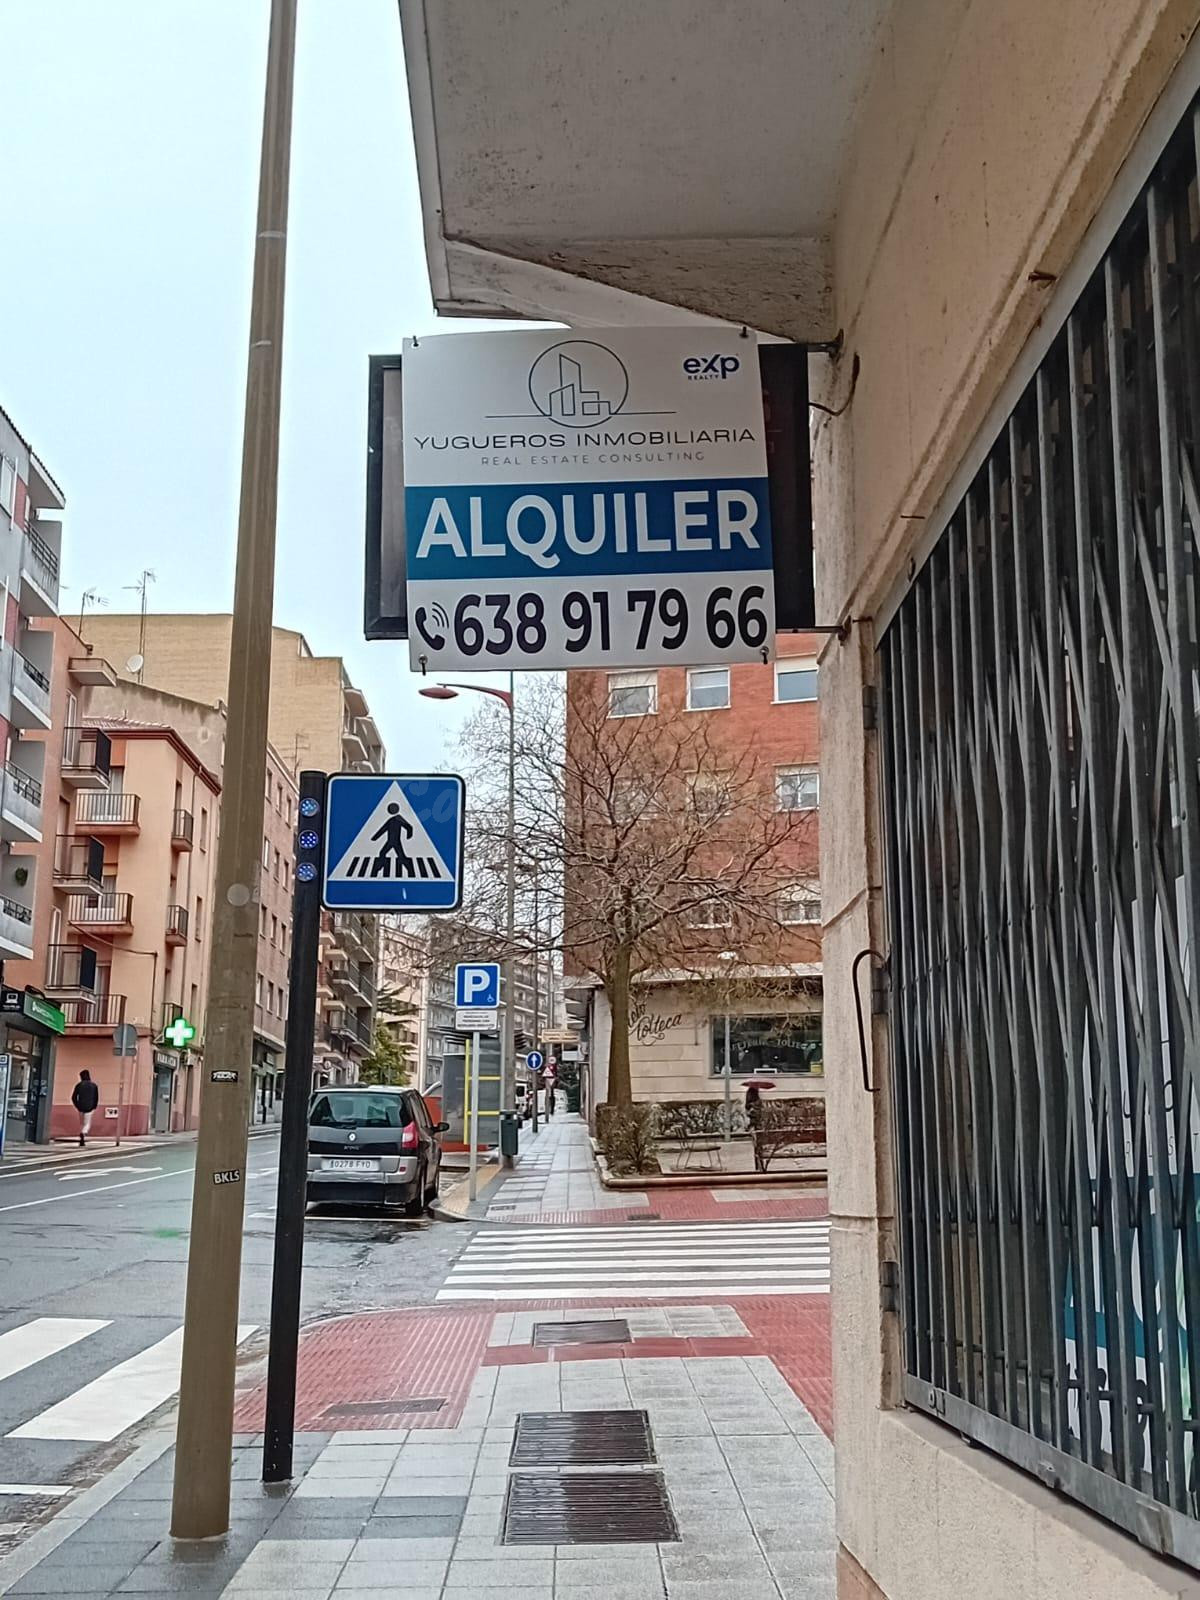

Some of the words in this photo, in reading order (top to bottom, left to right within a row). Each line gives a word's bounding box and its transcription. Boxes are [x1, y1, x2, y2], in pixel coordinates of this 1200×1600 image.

[414, 432, 566, 450] YUGUEROS
[577, 428, 755, 447] INMOBILIARIA
[481, 456, 521, 466] REAL
[531, 454, 589, 465] ESTATE
[599, 451, 705, 464] CONSULTING
[415, 489, 761, 569] ALQUILER
[454, 592, 547, 656] 638
[562, 590, 611, 653] 91
[627, 588, 689, 650] 79
[706, 585, 767, 649] 66
[464, 969, 490, 1003] P
[214, 1170, 240, 1184] BKLS
